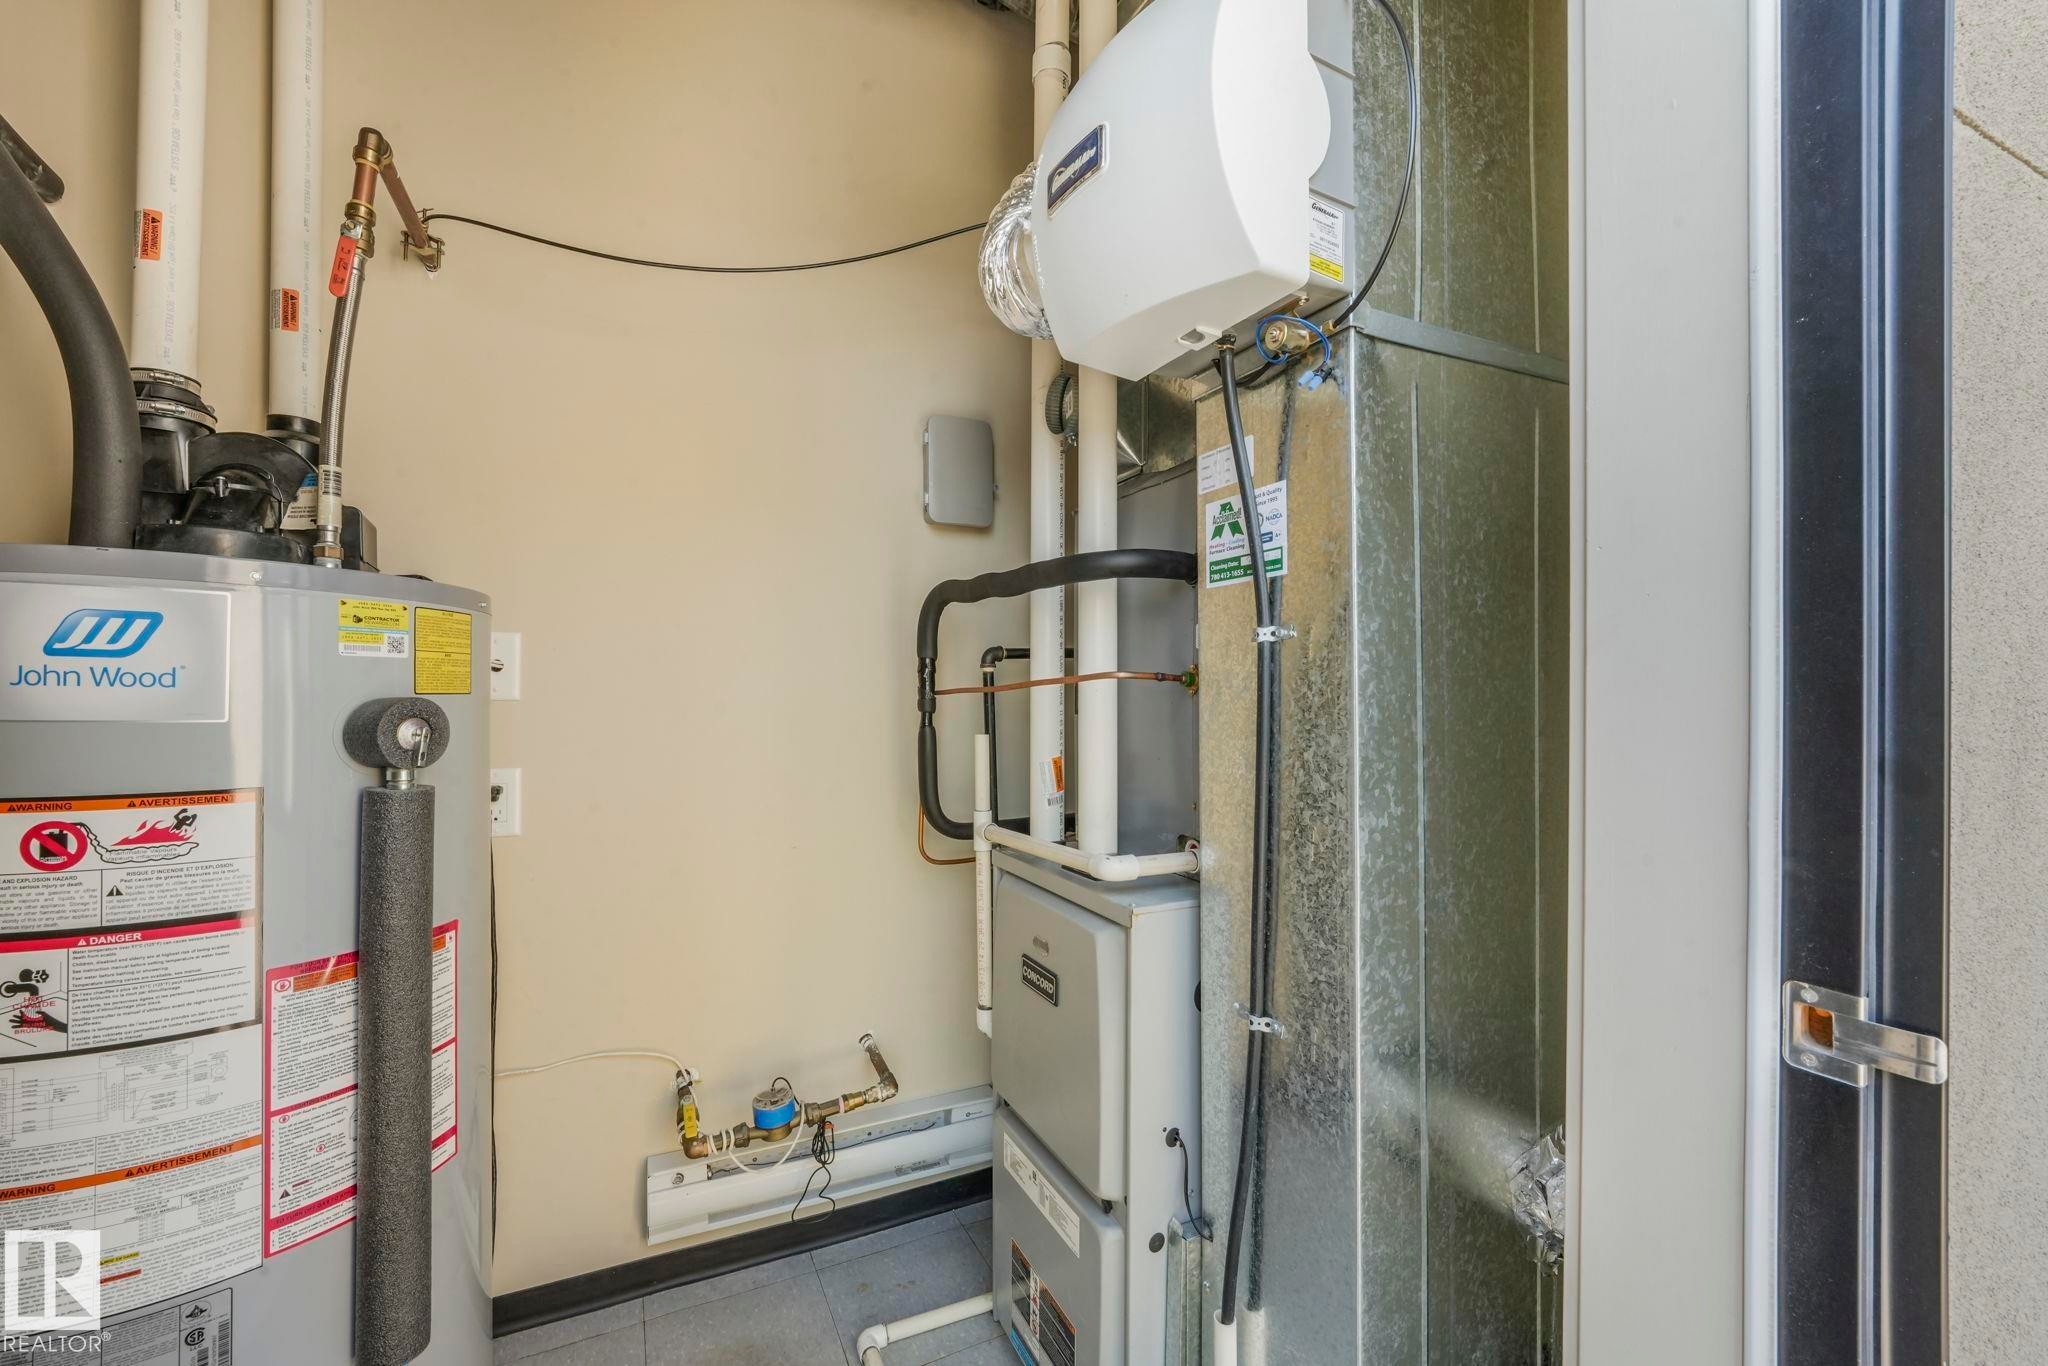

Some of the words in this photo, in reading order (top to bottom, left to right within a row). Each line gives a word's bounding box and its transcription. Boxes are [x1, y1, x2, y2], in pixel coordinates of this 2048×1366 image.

[1266, 488, 1282, 496] Quality
[9, 664, 81, 687] John
[89, 666, 176, 688] Wood
[16, 802, 72, 812] WARNING
[90, 932, 142, 945] DANGER
[1022, 966, 1054, 994] CONCORD
[136, 1144, 235, 1176] AVERTISSEMENT
[0, 1184, 56, 1199] WARNING
